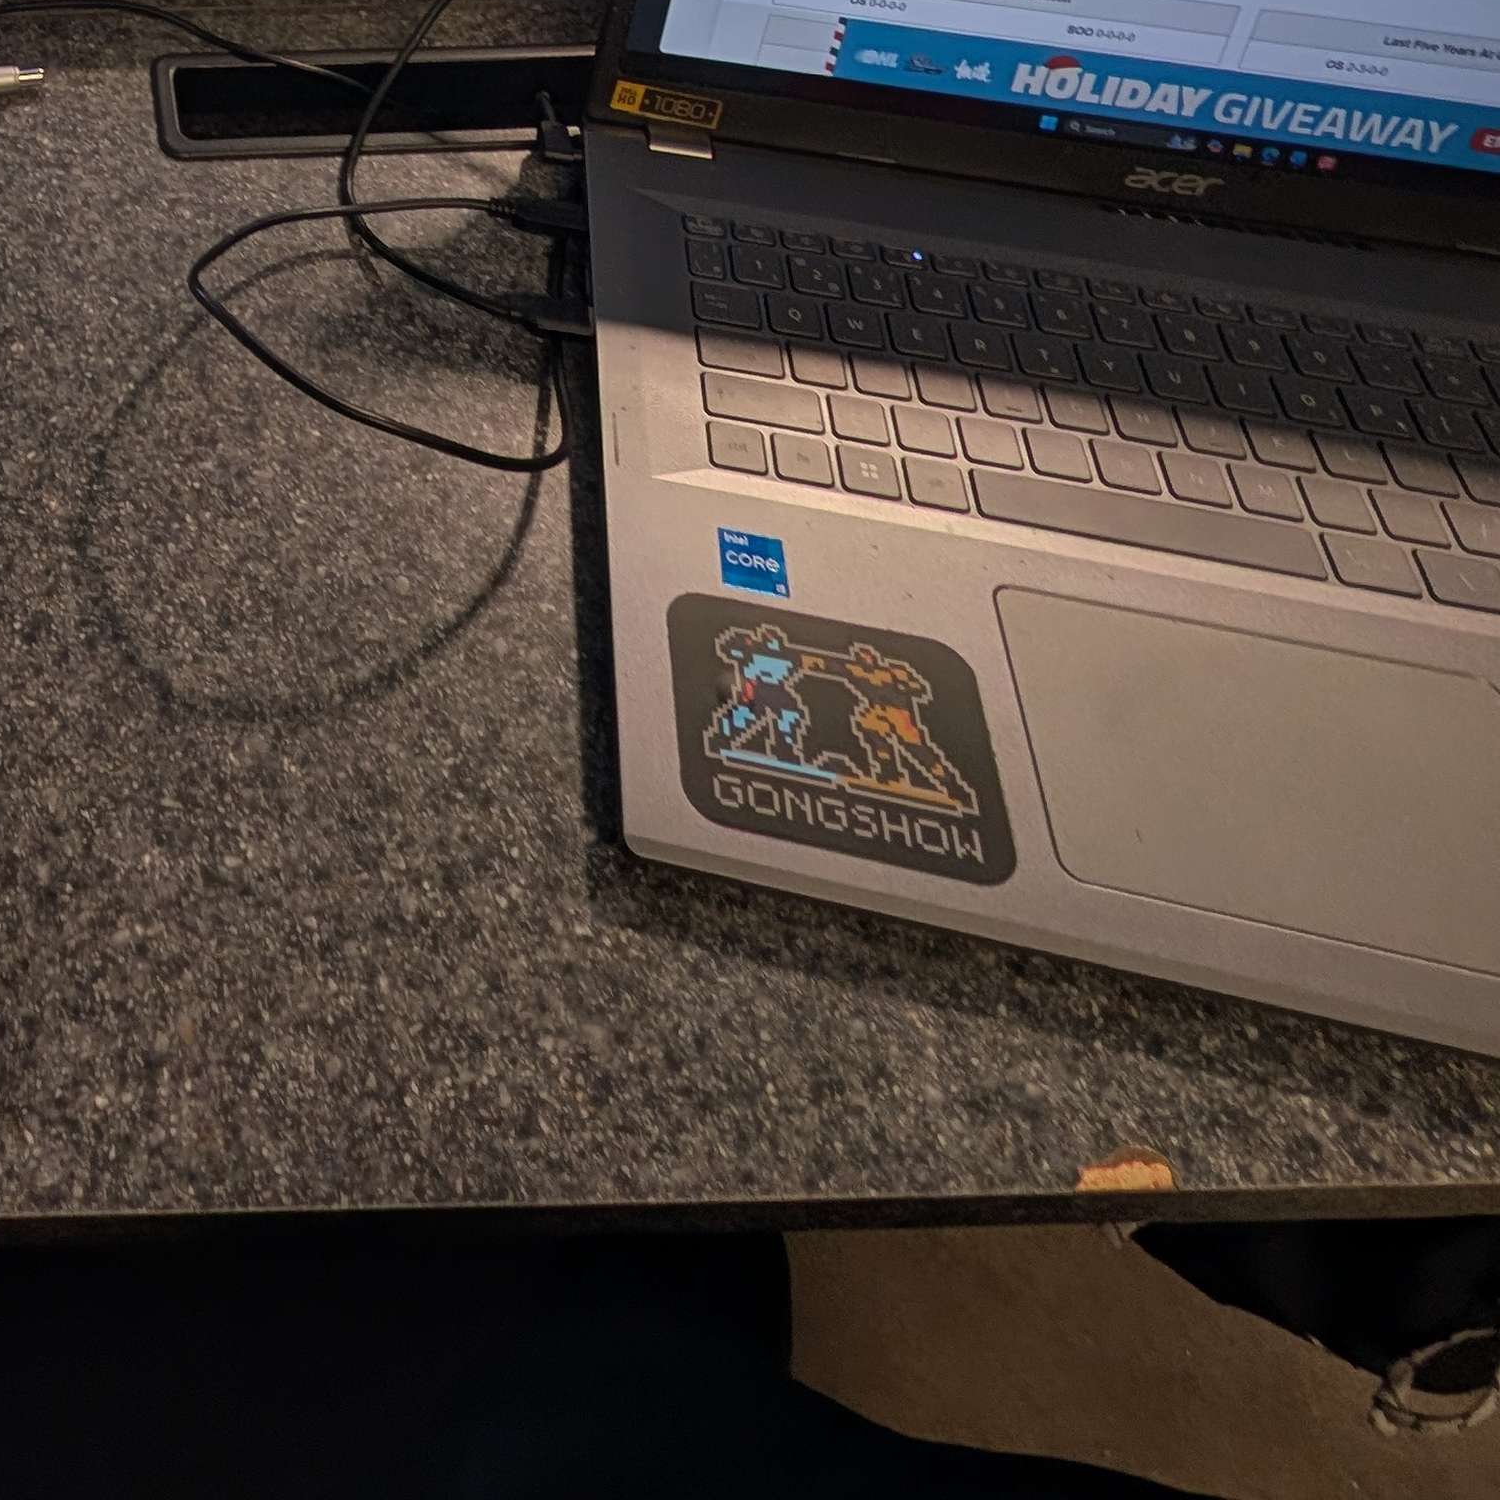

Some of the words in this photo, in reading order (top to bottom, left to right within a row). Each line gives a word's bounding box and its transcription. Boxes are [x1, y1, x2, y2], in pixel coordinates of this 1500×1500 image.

[654, 95, 706, 120] 1080
[1010, 60, 1211, 118] HOLIDAY
[1215, 91, 1459, 154] GIVEAWAY
[1124, 166, 1224, 197] acer
[713, 772, 985, 864] GONGSHOW
